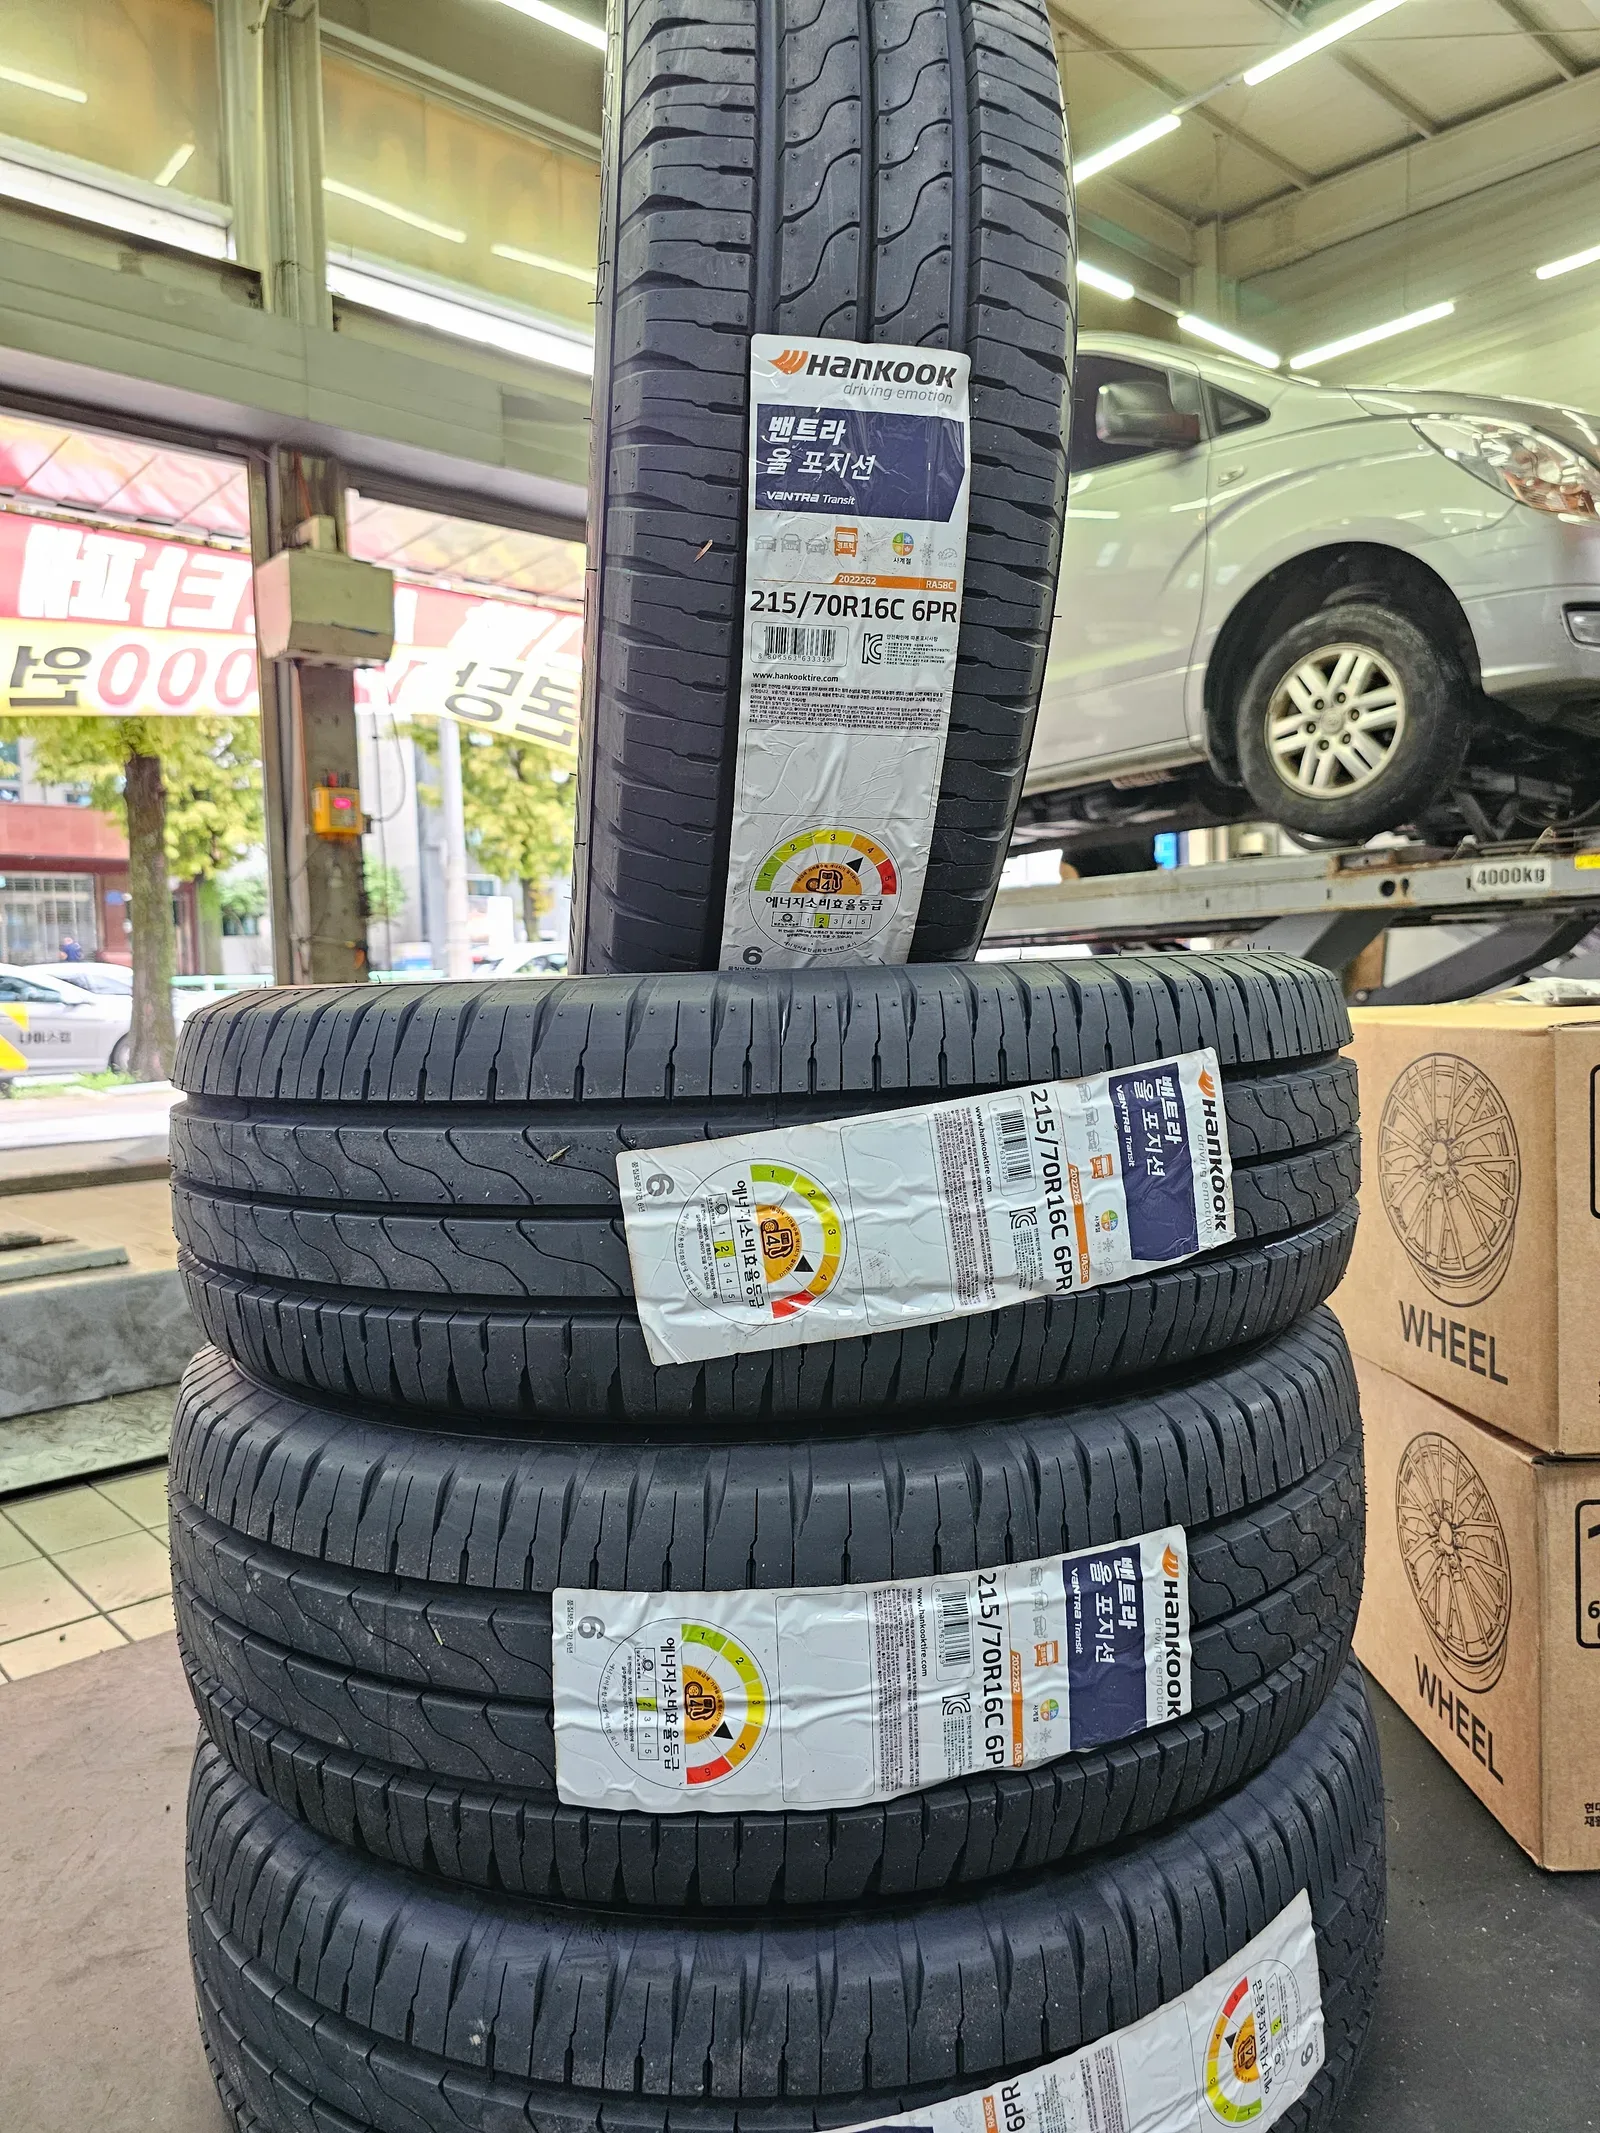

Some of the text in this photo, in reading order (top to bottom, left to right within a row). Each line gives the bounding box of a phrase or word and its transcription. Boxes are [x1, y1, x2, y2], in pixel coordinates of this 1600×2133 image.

[843, 382, 953, 405] driving emotion
[768, 416, 847, 445] 밴트라
[767, 448, 876, 481] 올 포지션
[822, 494, 856, 506] Transit
[893, 557, 912, 565] 사계절
[839, 574, 954, 590] 2022262 RA58C
[750, 591, 958, 623] 215/70R16C 6PR
[752, 671, 839, 683] www.hankooktire.com
[867, 846, 875, 854] 4
[821, 880, 831, 891] 4
[1476, 867, 1545, 885] 4000kg
[765, 896, 883, 911] 에너지소비효율등급
[743, 946, 763, 965] 6
[1155, 1075, 1183, 1145] 밴트라
[1133, 1080, 1166, 1177] 올 포지션
[975, 1106, 992, 1192] www.hankooktire.com
[1127, 1135, 1136, 1167] Transit
[645, 1173, 675, 1197] 6
[770, 1170, 776, 1178] 1
[1197, 1134, 1214, 1234] driving emotion
[807, 1189, 816, 1198] 2
[1030, 1088, 1073, 1292] 215/70R16C 6PR
[1069, 1168, 1089, 1283] 2022262 RA58C
[731, 1179, 765, 1309] 에너지소비효율등급
[766, 1235, 781, 1247] 4
[819, 1273, 828, 1281] 4
[1398, 1299, 1508, 1386] WHEEL
[1113, 1556, 1138, 1630] 밴트라
[1089, 1560, 1116, 1663] 올 포지션
[577, 1615, 606, 1639] 6
[701, 1632, 706, 1640] 1
[917, 1587, 927, 1677] www.hankooktire.com
[1074, 1621, 1084, 1655] Transit
[735, 1657, 744, 1665] 2
[977, 1572, 1004, 1729] 215/70R16C
[1012, 1655, 1020, 1694] 2022262
[1154, 1617, 1165, 1721] driving emotion
[660, 1637, 680, 1771] 에너지소비효율등급
[1414, 1653, 1504, 1786] WHEEL
[738, 1742, 746, 1750] 4
[704, 1768, 711, 1776] 5
[1300, 2042, 1315, 2067] 6
[984, 2097, 995, 2128] RA58C
[1001, 2081, 1026, 2133] 6PR
